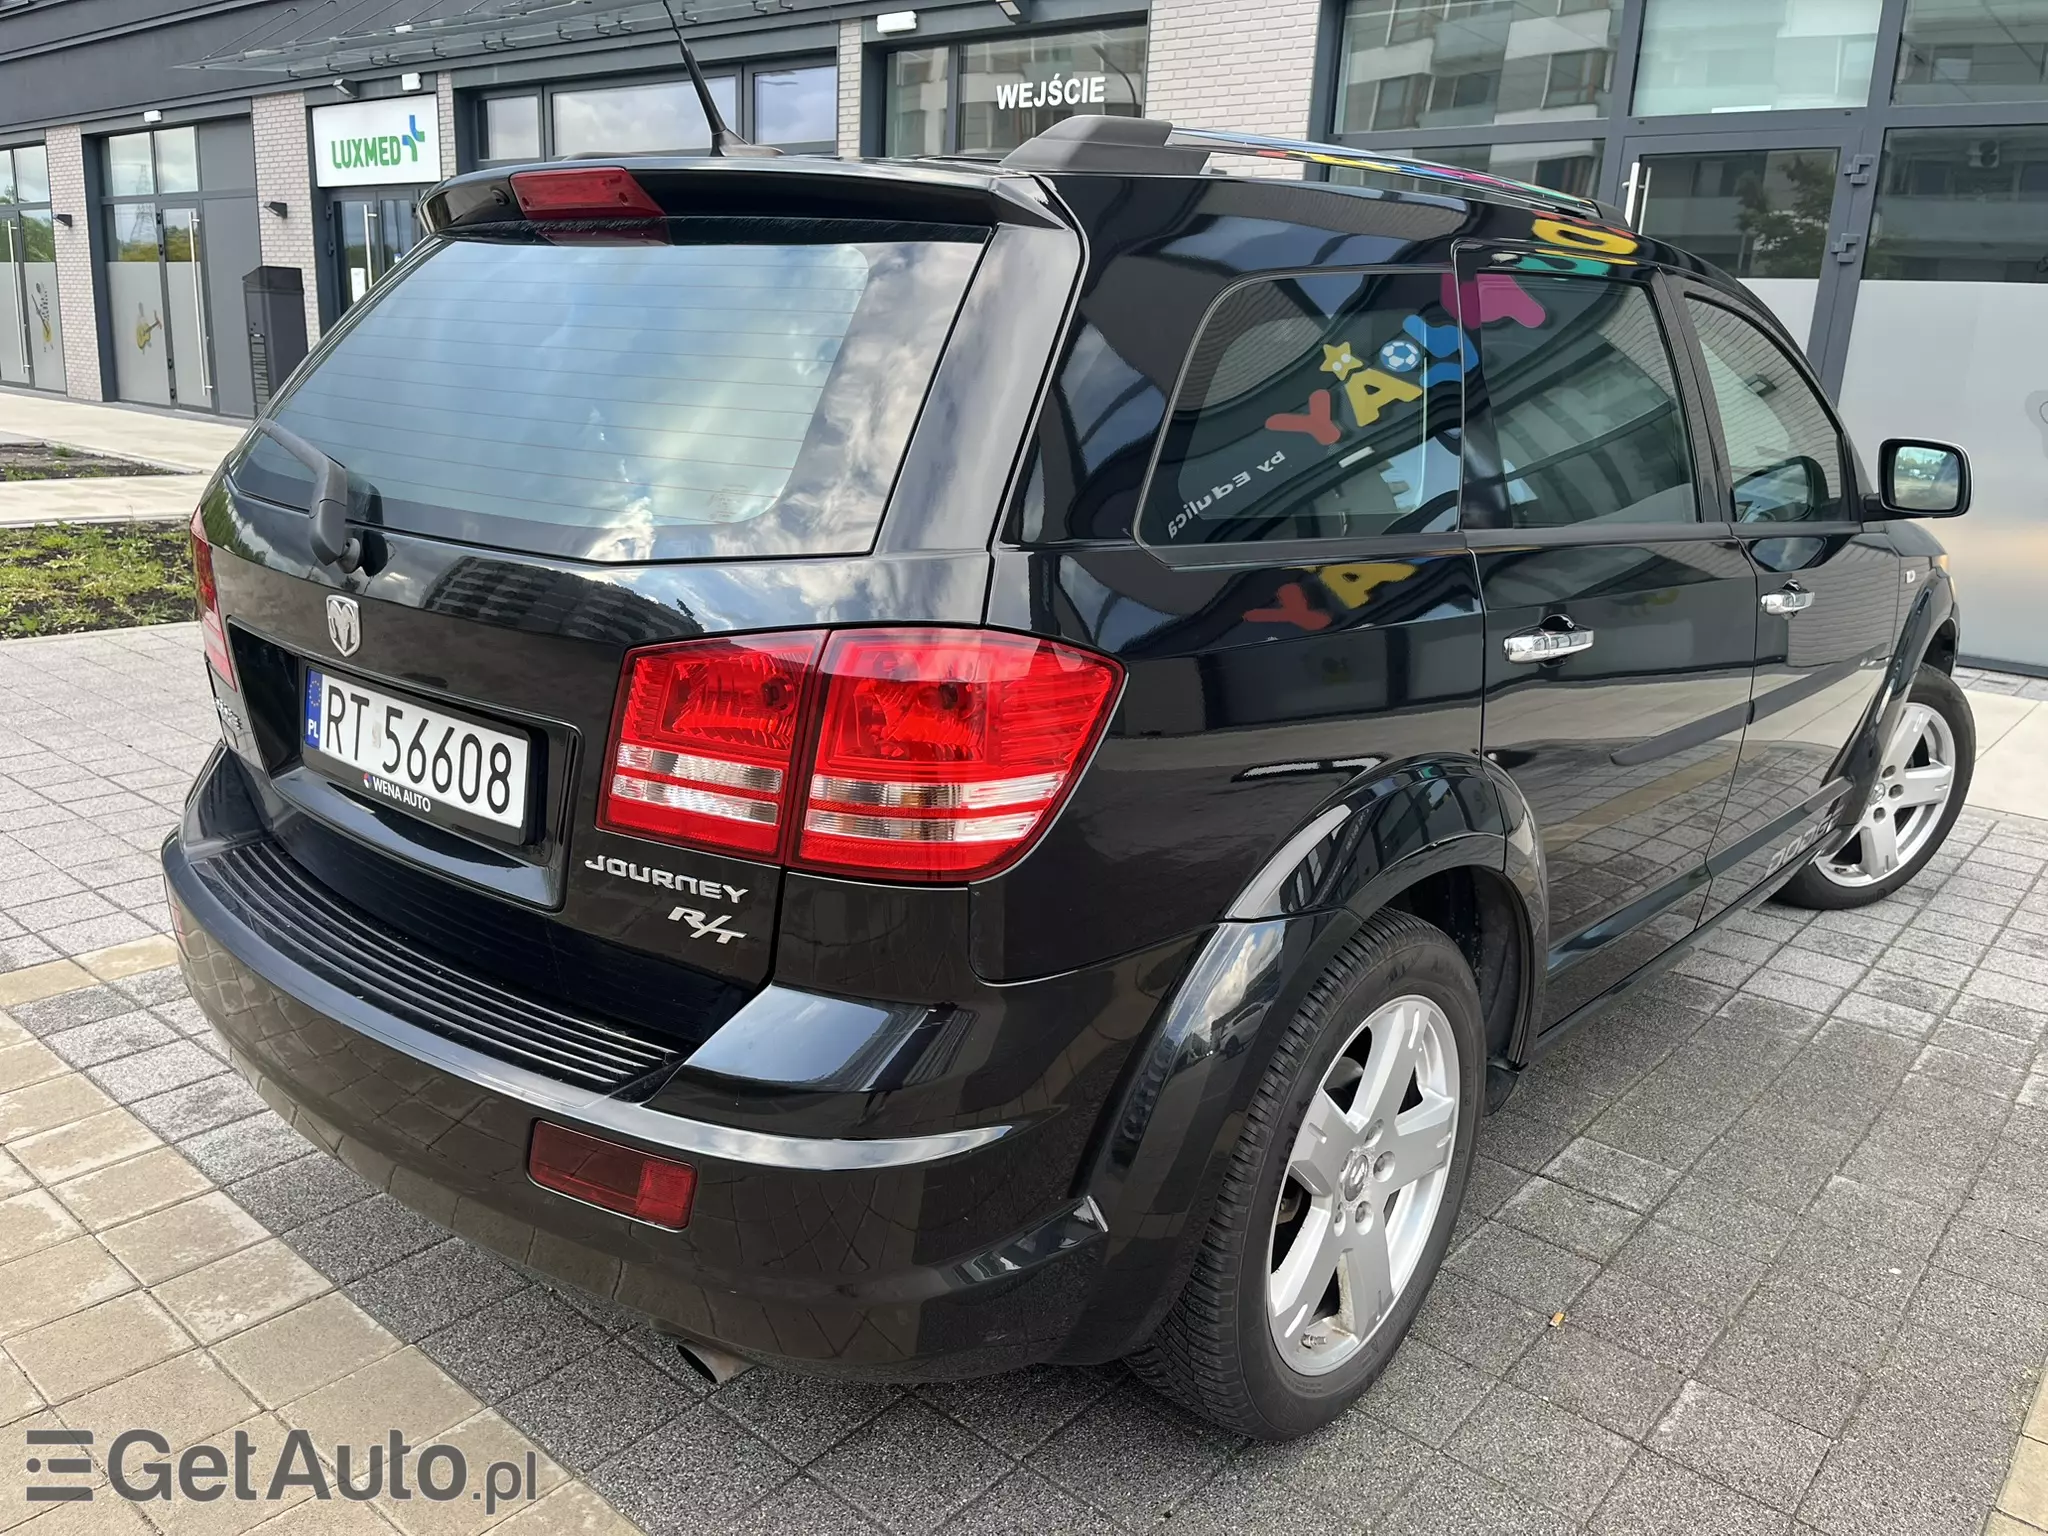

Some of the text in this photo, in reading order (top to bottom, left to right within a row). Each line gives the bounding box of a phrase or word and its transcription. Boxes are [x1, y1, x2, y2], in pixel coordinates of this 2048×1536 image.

[996, 73, 1106, 110] WEJŚCIE
[331, 135, 401, 169] LUXMED
[307, 718, 319, 739] PL
[326, 684, 512, 814] RT 56608
[372, 775, 431, 813] WENA AUTO
[584, 855, 749, 904] JOURNEY
[667, 906, 748, 945] R/T
